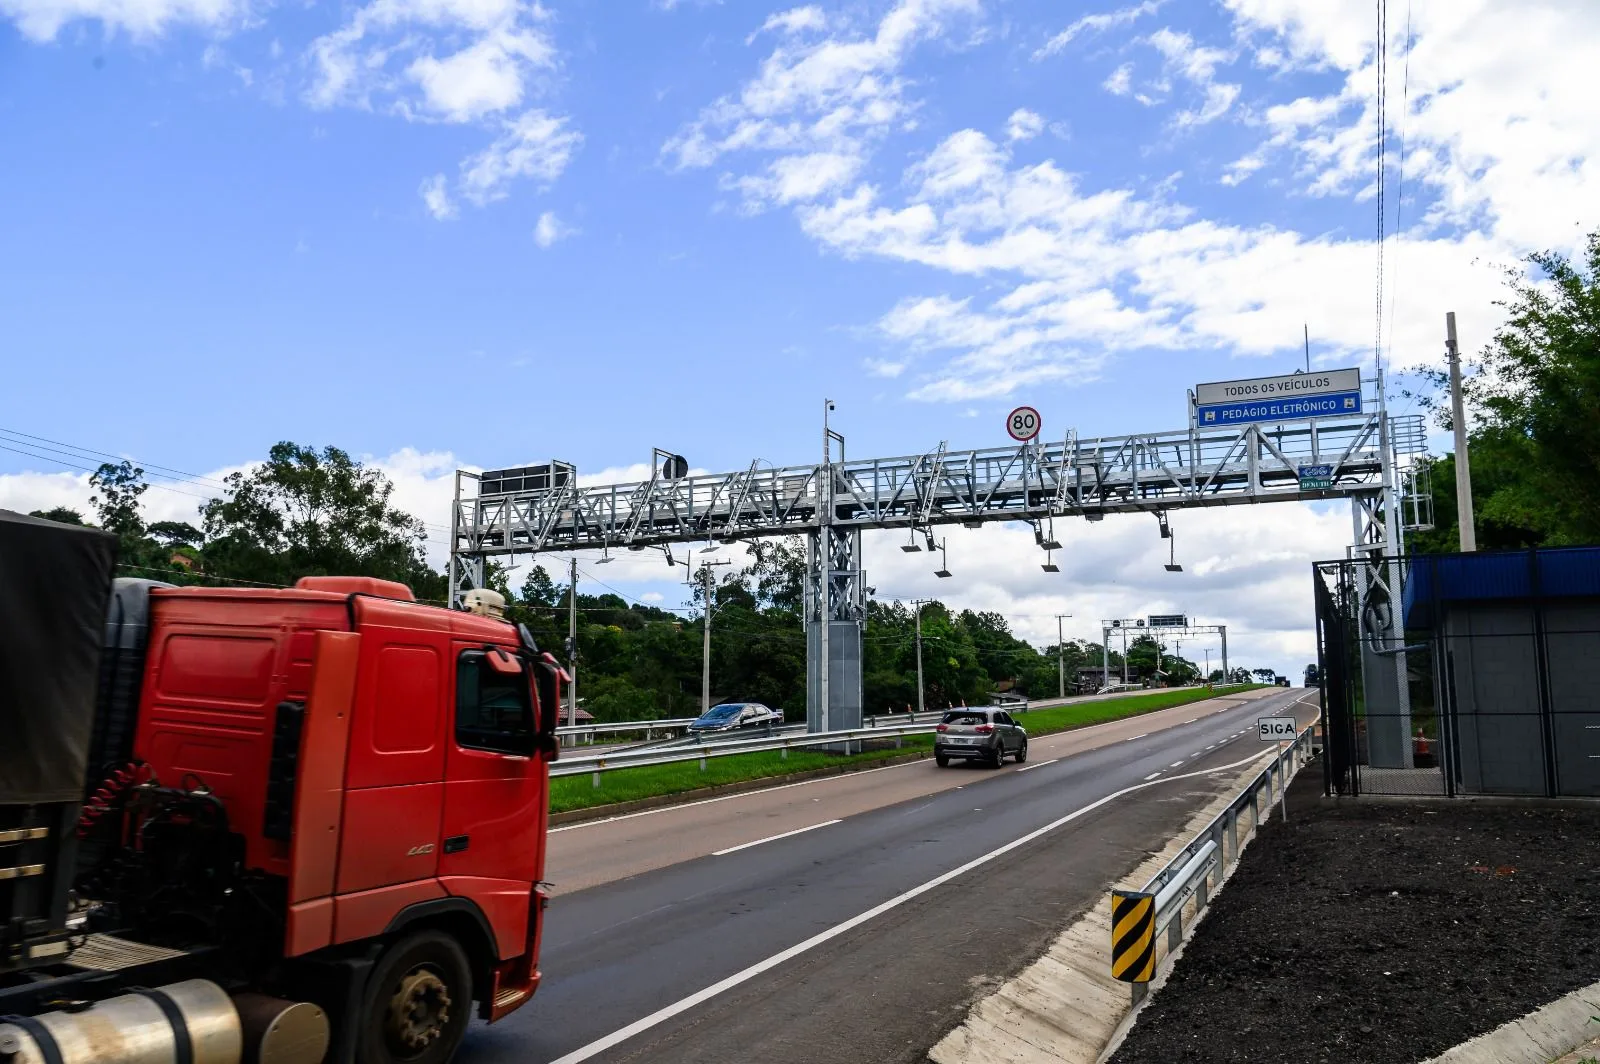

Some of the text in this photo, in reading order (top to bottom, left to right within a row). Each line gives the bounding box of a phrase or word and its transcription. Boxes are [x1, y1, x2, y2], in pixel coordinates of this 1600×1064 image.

[1224, 377, 1330, 397] TODOS OS VEÍCULOS
[1222, 400, 1337, 419] PEDÁGIO ELETRÔNICO
[1013, 414, 1035, 430] 80
[1261, 723, 1295, 734] SIGA
